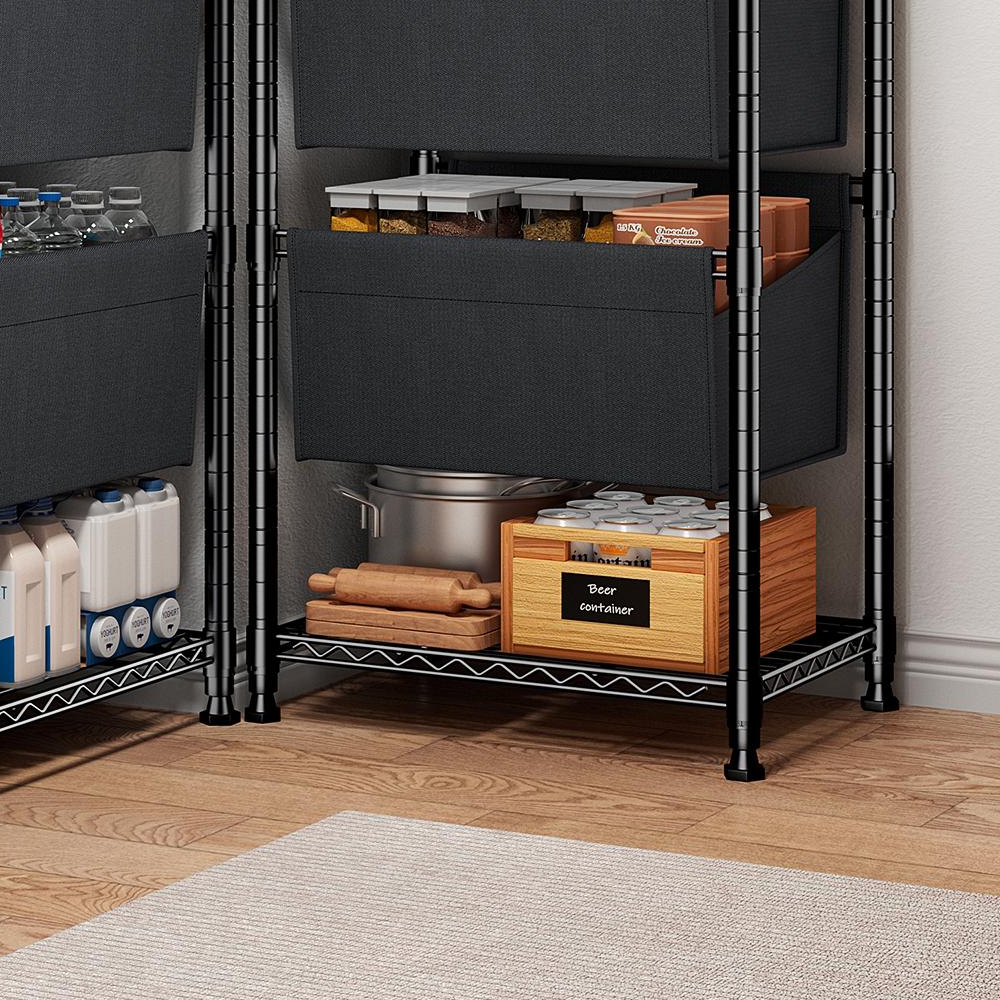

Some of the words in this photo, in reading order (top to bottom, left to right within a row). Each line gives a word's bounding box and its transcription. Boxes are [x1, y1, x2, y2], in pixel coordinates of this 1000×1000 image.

[655, 226, 699, 237] Chocolate
[655, 236, 672, 245] Ice
[672, 237, 704, 246] cream
[587, 583, 617, 596] Beer
[580, 602, 634, 616] container
